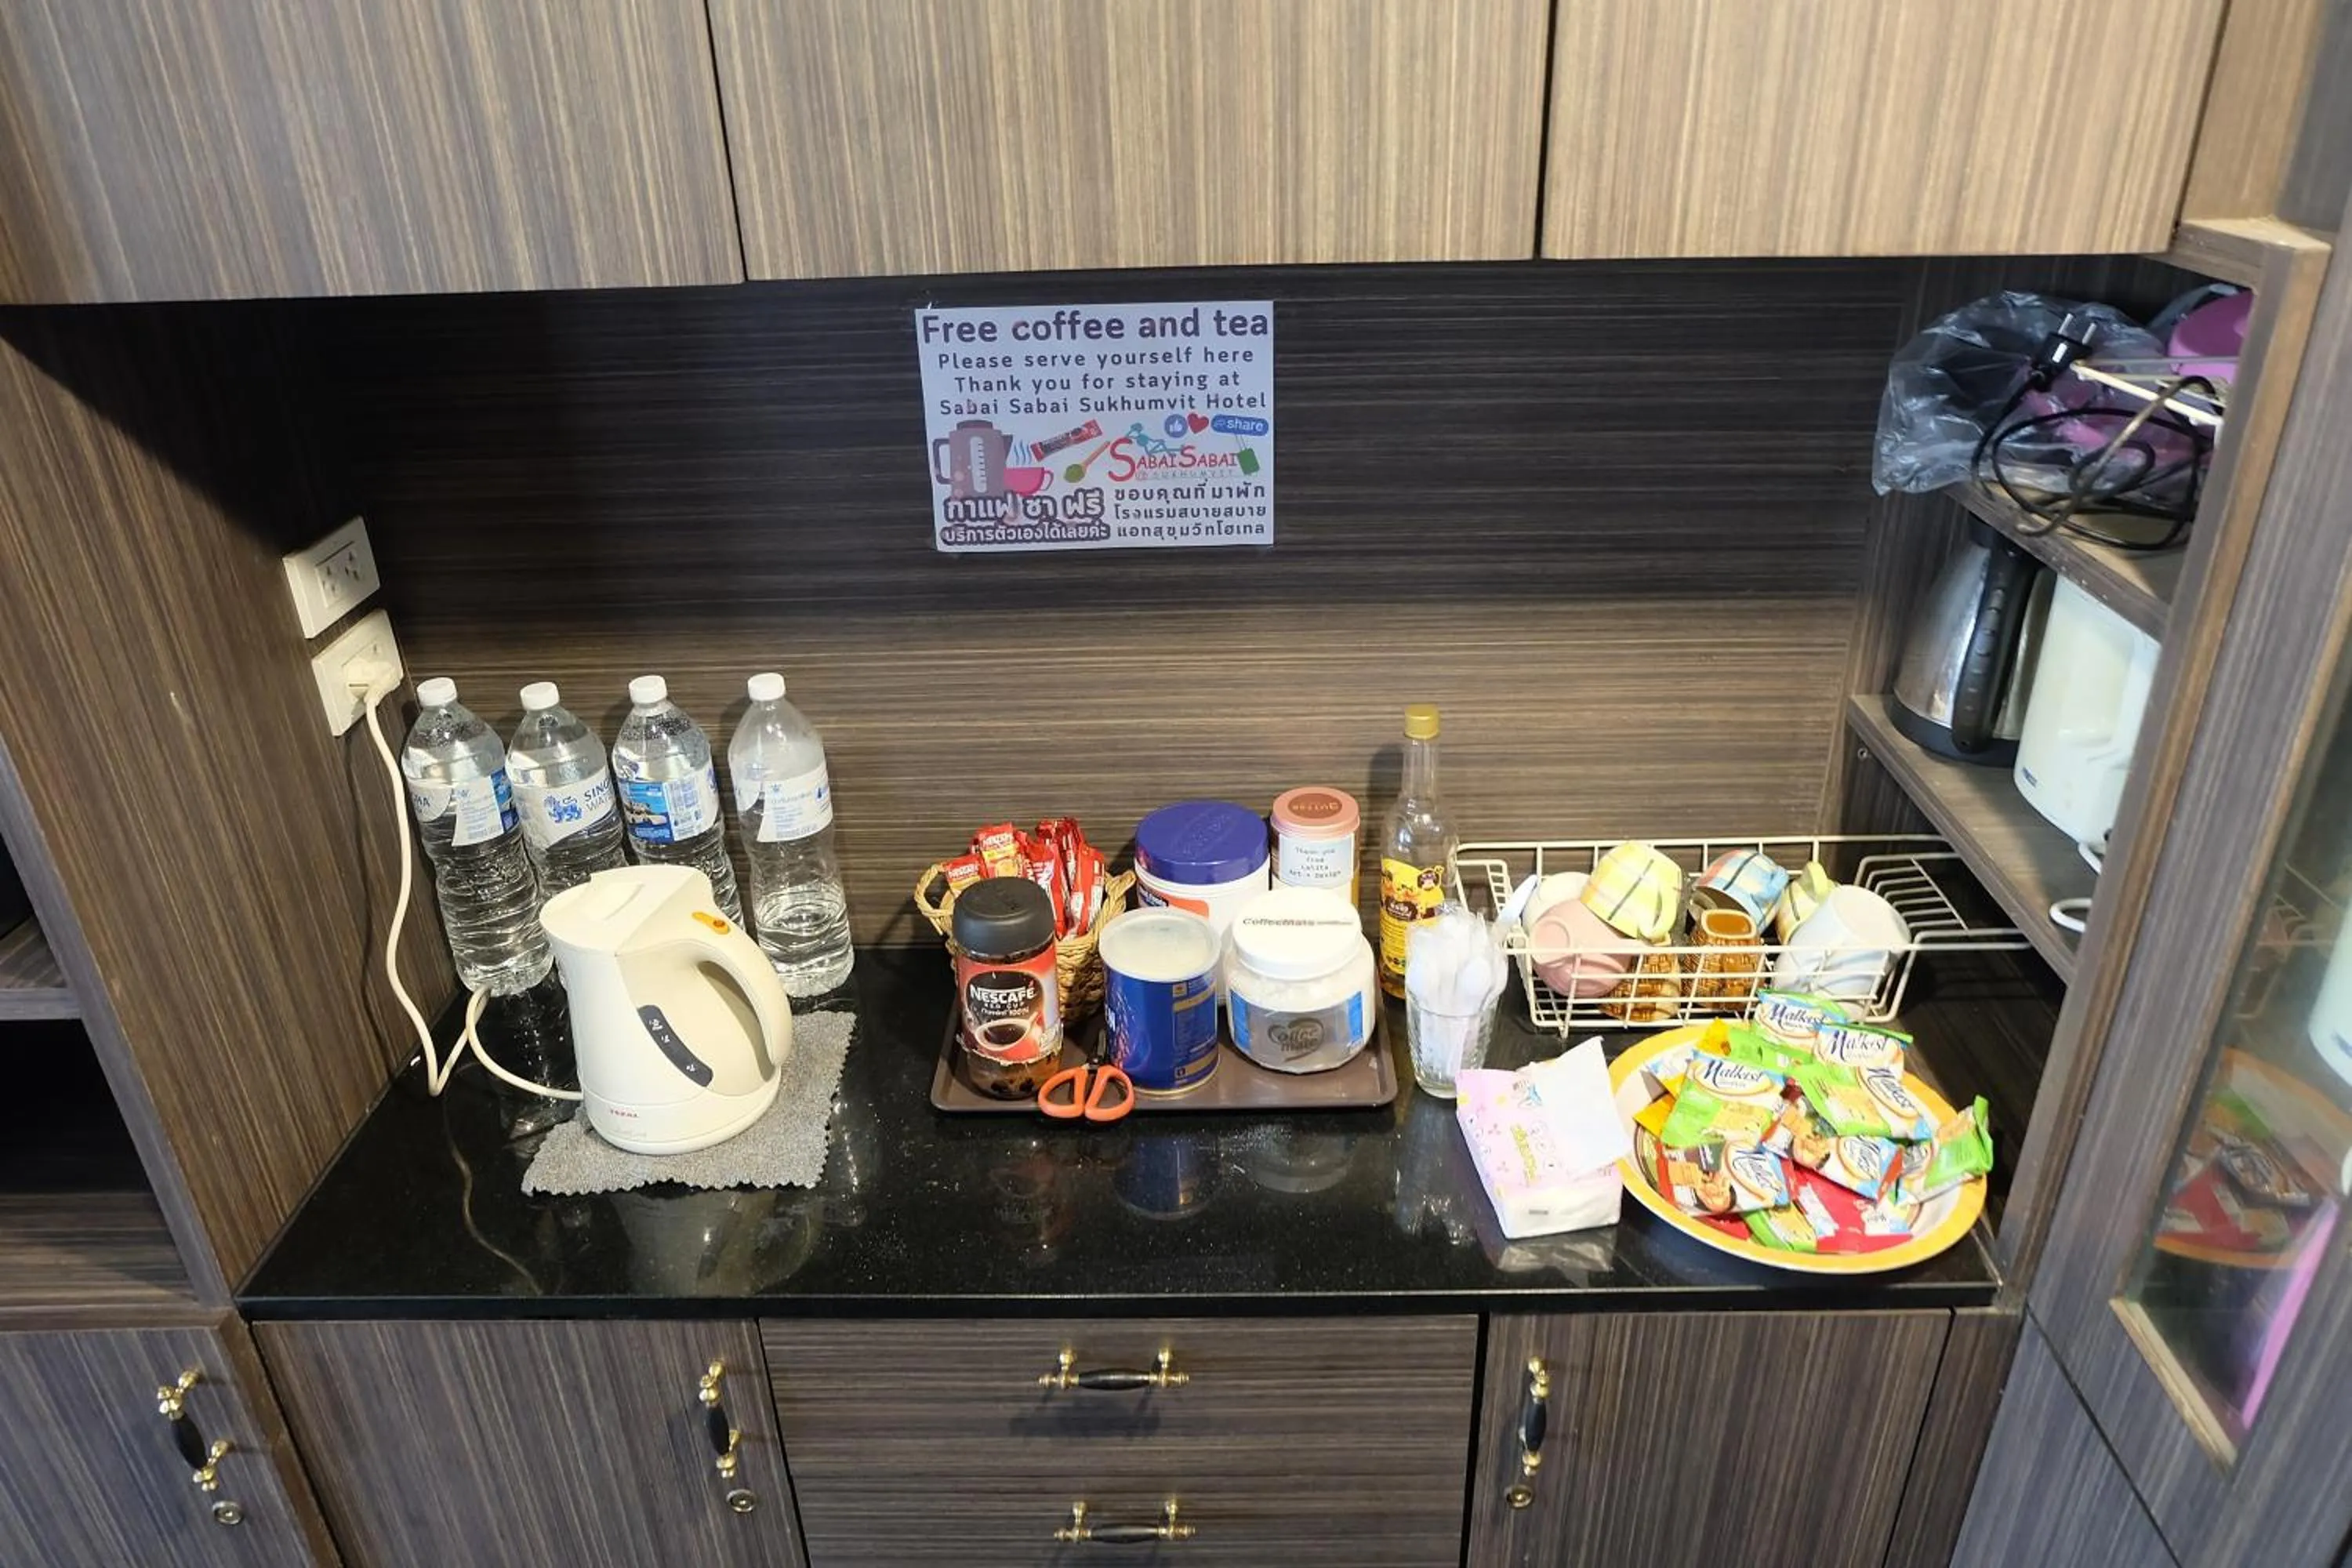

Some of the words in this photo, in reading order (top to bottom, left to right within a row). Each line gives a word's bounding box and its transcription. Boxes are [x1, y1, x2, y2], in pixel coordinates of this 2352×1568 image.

[922, 315, 998, 343] Free
[1011, 310, 1125, 341] coffee
[1138, 307, 1200, 339] and
[1213, 310, 1268, 336] tea
[938, 352, 1013, 369] Please
[1024, 353, 1086, 368] serve
[1097, 346, 1192, 370] yourself
[1203, 346, 1254, 363] here
[954, 375, 1022, 393] Thank
[1032, 377, 1071, 395] you
[1082, 373, 1114, 390] for
[1126, 370, 1209, 391] staying
[1218, 371, 1240, 387] at
[940, 398, 998, 416] Sabai
[1009, 397, 1069, 415] Sabai
[1080, 394, 1196, 413] Sukhumvit
[1206, 391, 1266, 409] Hotel
[1226, 419, 1265, 432] share
[945, 491, 1017, 521] กาแฟ
[1024, 496, 1056, 520] ชา
[1063, 488, 1104, 519] ฟรี
[969, 979, 1036, 1004] NESCAFÉ
